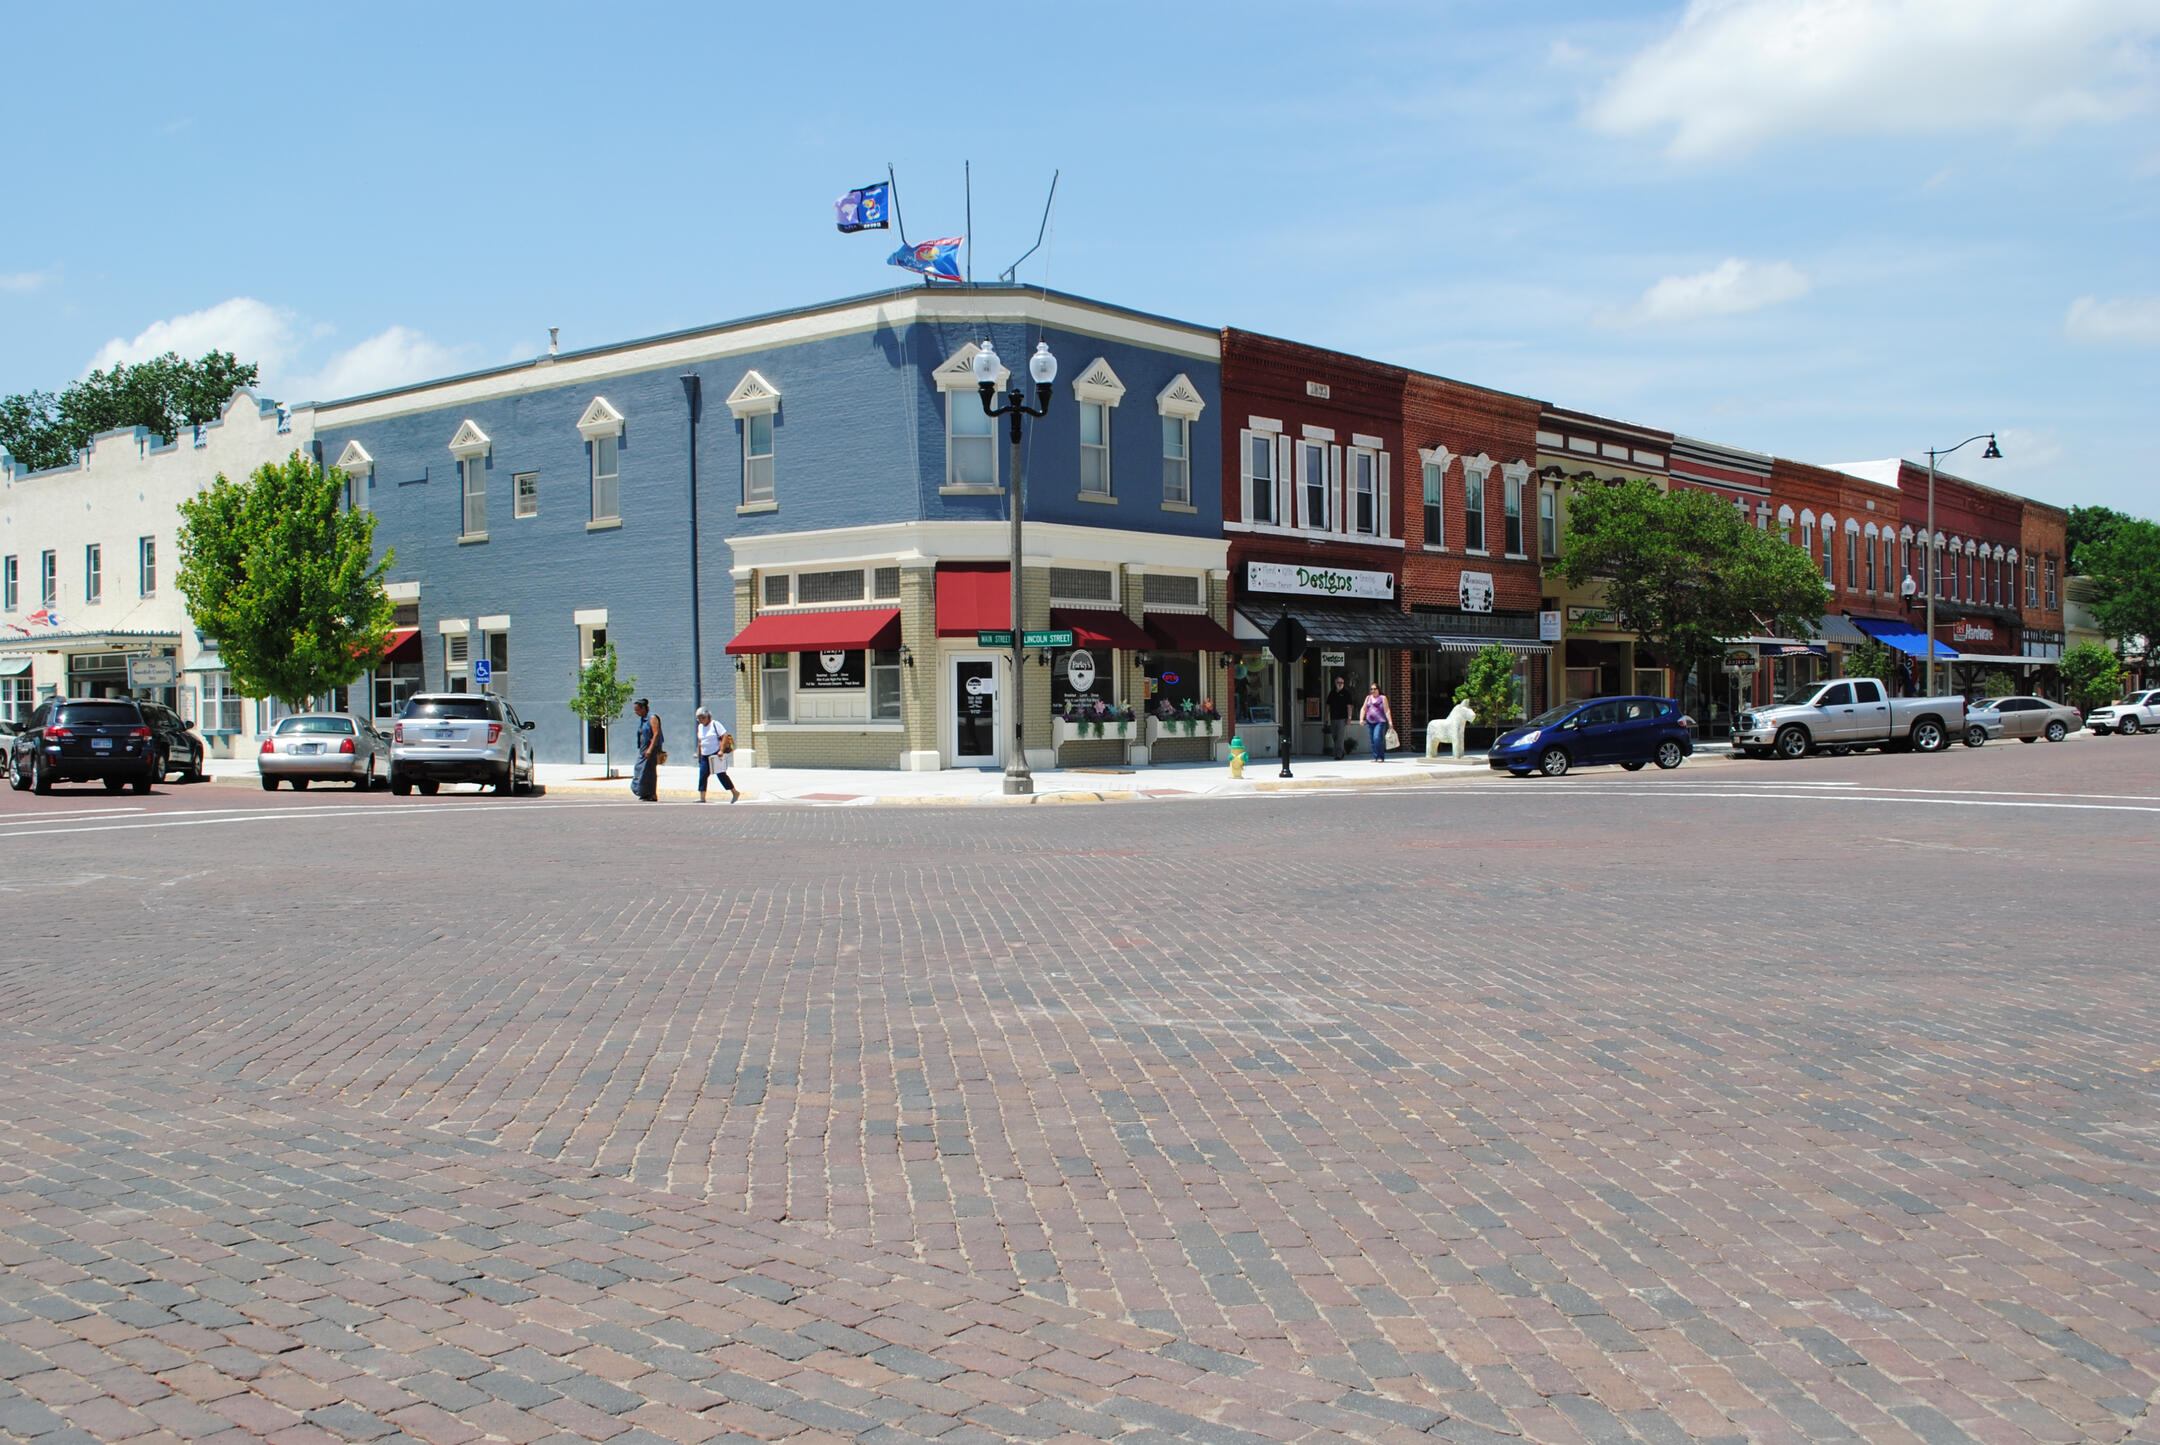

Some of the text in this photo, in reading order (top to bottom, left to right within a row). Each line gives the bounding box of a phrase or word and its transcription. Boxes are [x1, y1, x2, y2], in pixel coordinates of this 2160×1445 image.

[1296, 567, 1353, 594] Designs
[1965, 624, 1993, 640] Hardware
[981, 635, 1011, 643] MAIN STREET
[1024, 634, 1070, 643] LINCOLN STREET
